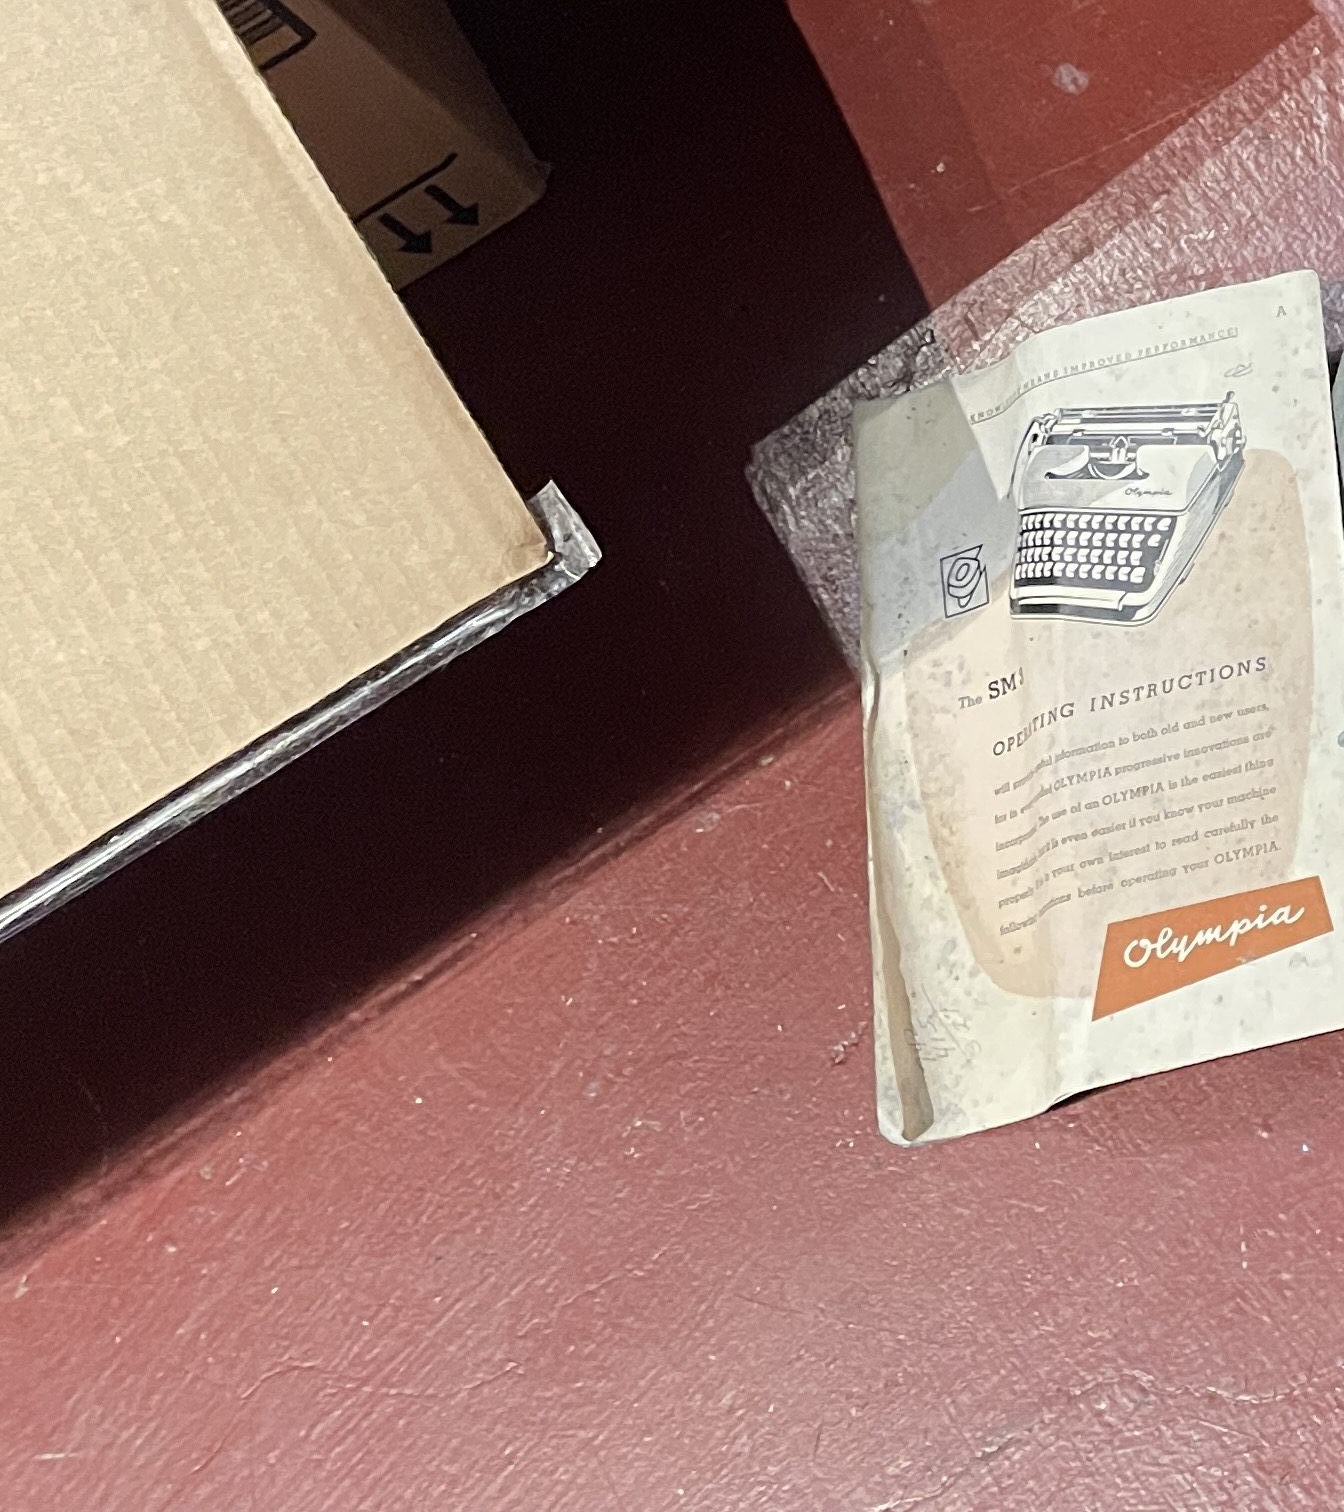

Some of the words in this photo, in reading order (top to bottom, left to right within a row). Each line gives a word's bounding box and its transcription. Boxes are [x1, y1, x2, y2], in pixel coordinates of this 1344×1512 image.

[958, 695, 983, 709] The
[993, 702, 1075, 756] OPETING
[1090, 656, 1267, 712] INSTRUCTIONS
[1118, 736, 1130, 747] to
[1132, 727, 1158, 742] both
[1161, 722, 1180, 736] old
[1183, 715, 1206, 730] and
[1209, 710, 1234, 724] new
[1237, 703, 1270, 717] users,
[1053, 766, 1113, 792] OLYMPIA
[1114, 751, 1181, 777] progressive
[1183, 735, 1250, 759] innovations
[1252, 729, 1273, 742] are
[1070, 801, 1081, 814] of
[1084, 800, 1100, 810] an
[1101, 781, 1165, 807] OLYMPIA
[1168, 779, 1178, 790] is
[1181, 775, 1199, 788] the
[1202, 766, 1242, 782] easiest
[1245, 757, 1275, 773] thing
[1079, 856, 1104, 869] own
[1108, 843, 1151, 862] interest
[1155, 840, 1167, 851] to
[1172, 829, 1199, 847] read
[1204, 817, 1257, 839] carefully
[1260, 812, 1279, 826] the
[1091, 821, 1127, 838] easier
[1139, 812, 1161, 828] you
[1163, 805, 1195, 821] know
[1197, 798, 1225, 813] your
[1227, 786, 1277, 805] machine
[1078, 882, 1114, 898] before
[1120, 866, 1178, 888] operating
[1182, 858, 1210, 874] your
[1213, 840, 1282, 865] OLYMPIA.
[1123, 903, 1306, 968] Olympia
